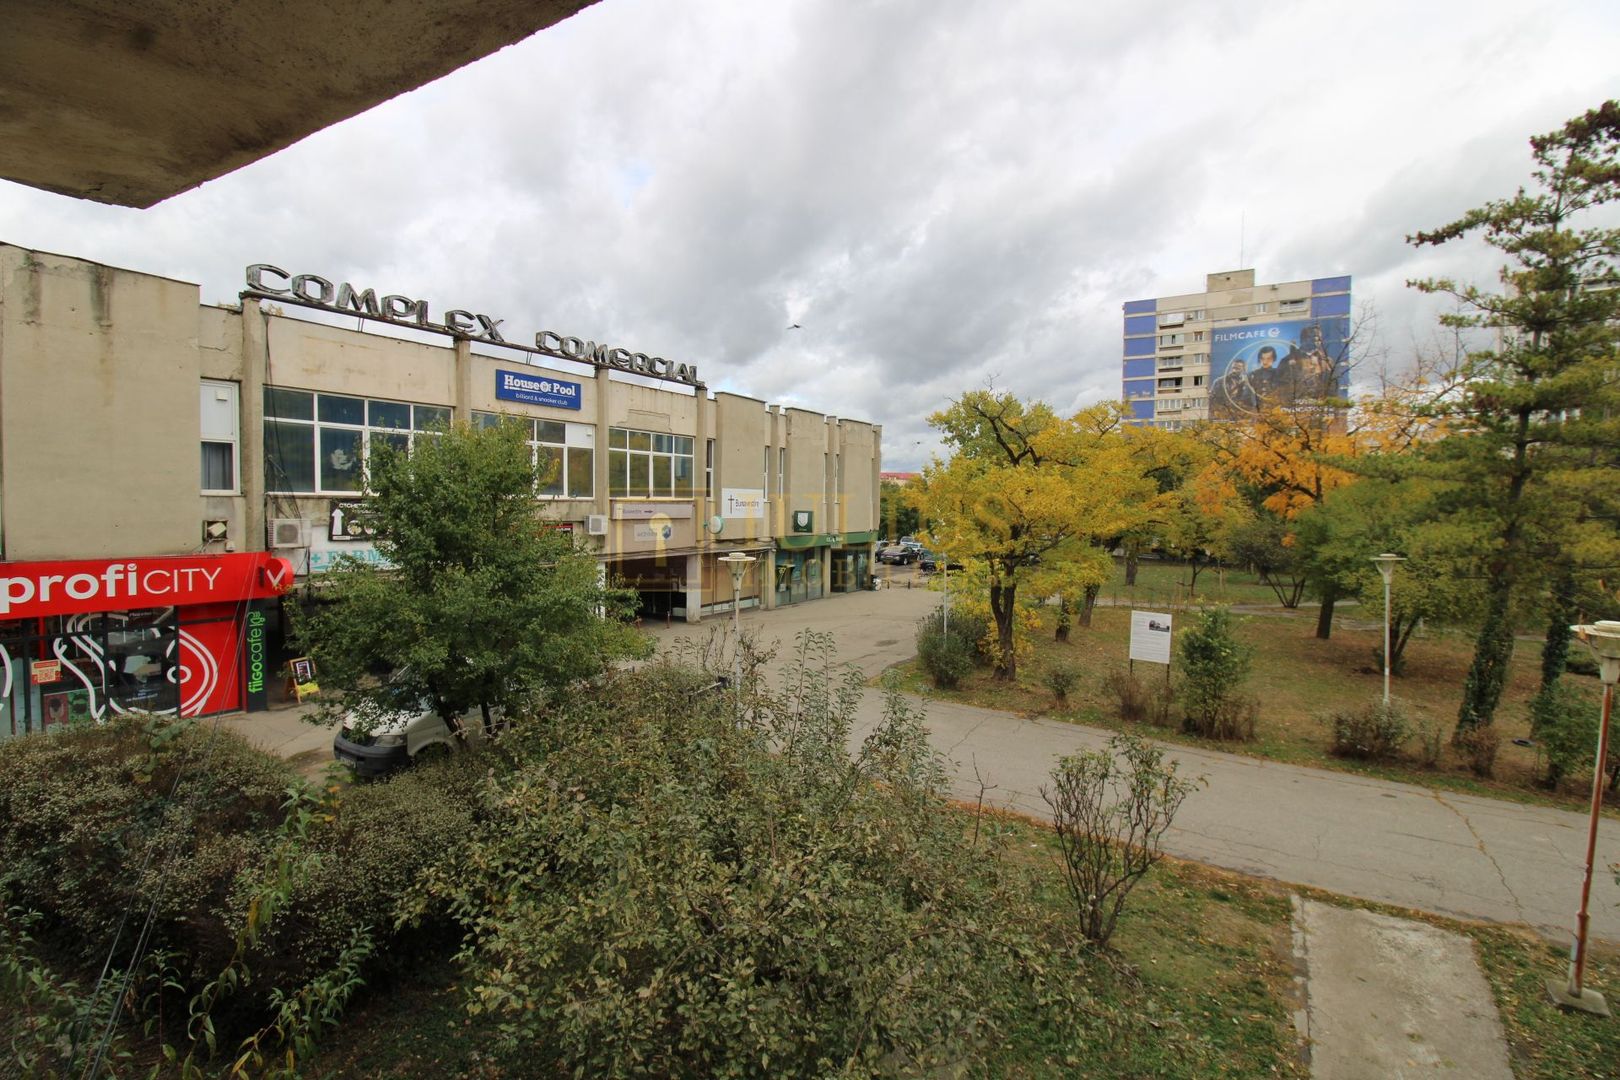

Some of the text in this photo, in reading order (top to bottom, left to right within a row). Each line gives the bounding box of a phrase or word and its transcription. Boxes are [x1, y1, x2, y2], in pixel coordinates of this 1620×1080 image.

[246, 263, 706, 387] COMPLEX COMERCIAL
[1214, 330, 1266, 342] FILMCAFE
[504, 374, 540, 390] House
[553, 383, 576, 396] Pool
[0, 563, 222, 614] profi CITY
